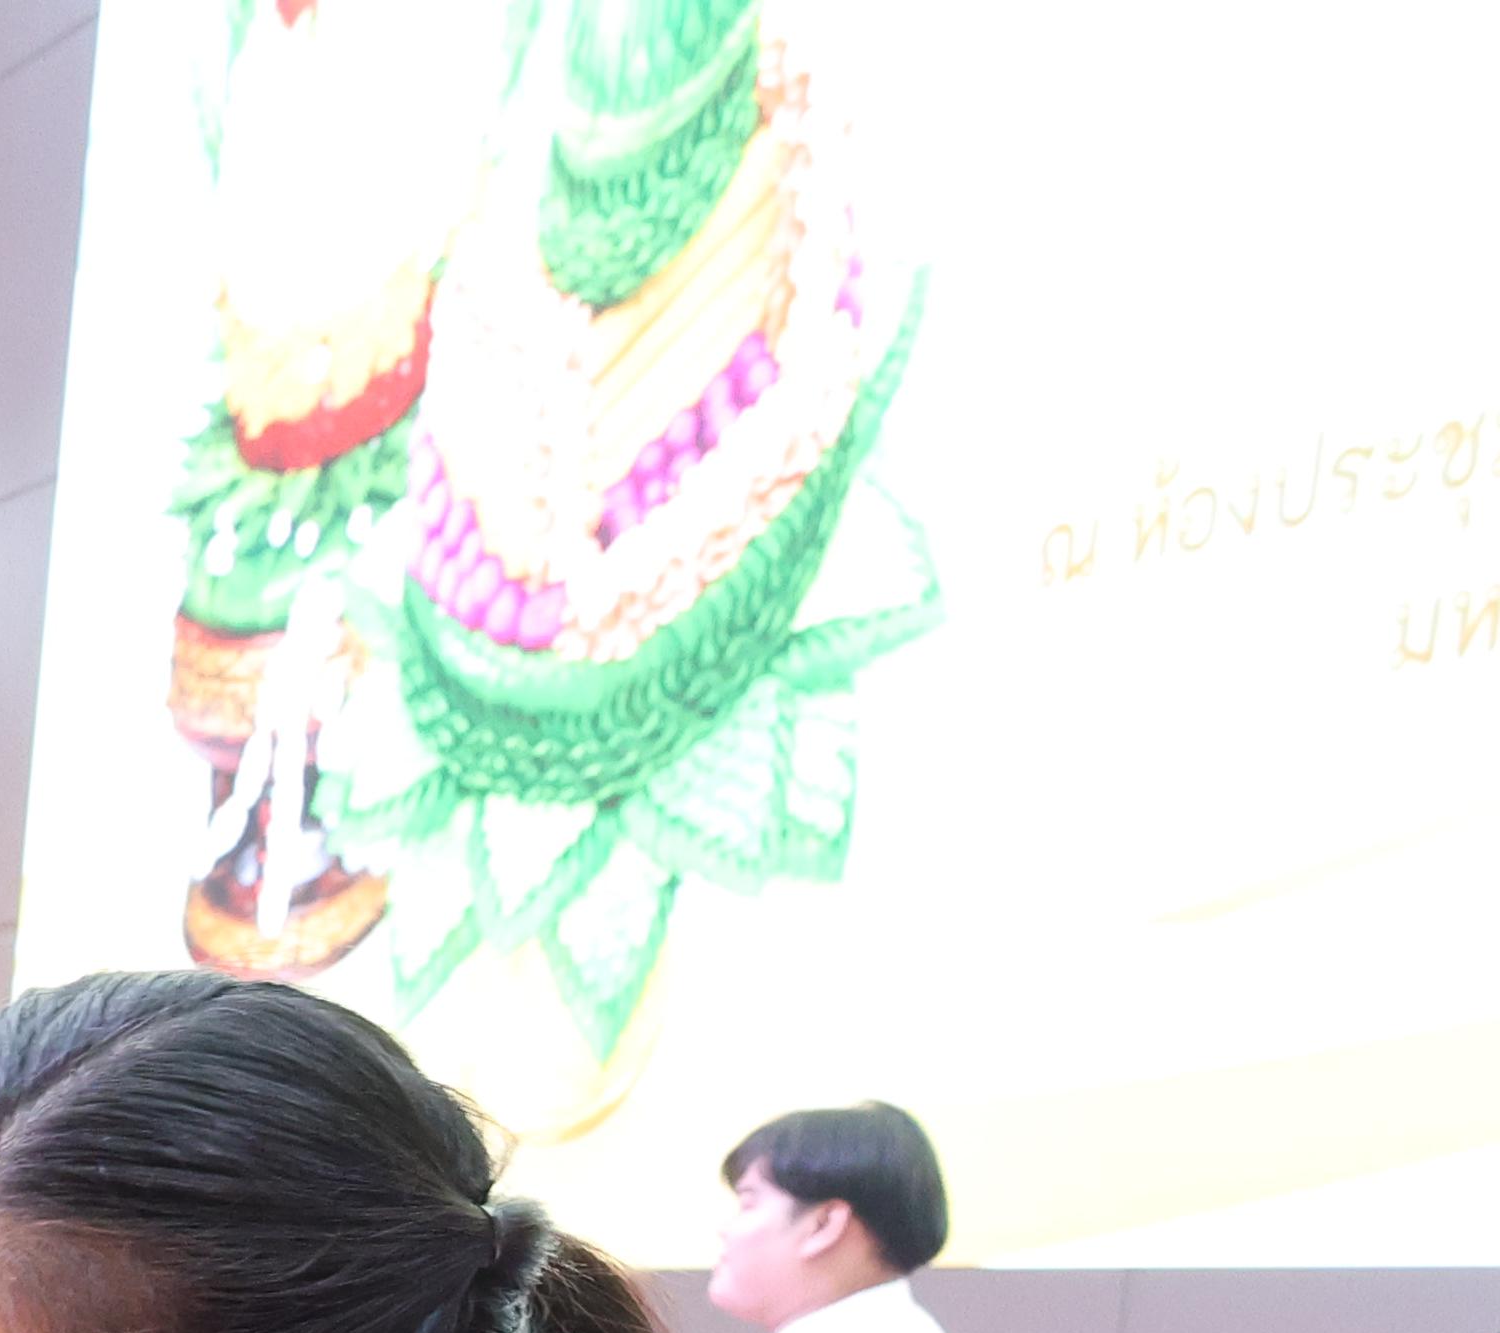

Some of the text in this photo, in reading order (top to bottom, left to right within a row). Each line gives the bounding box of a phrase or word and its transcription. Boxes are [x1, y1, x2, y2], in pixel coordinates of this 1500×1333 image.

[1040, 410, 1500, 588] ณ ห้องประชุ
